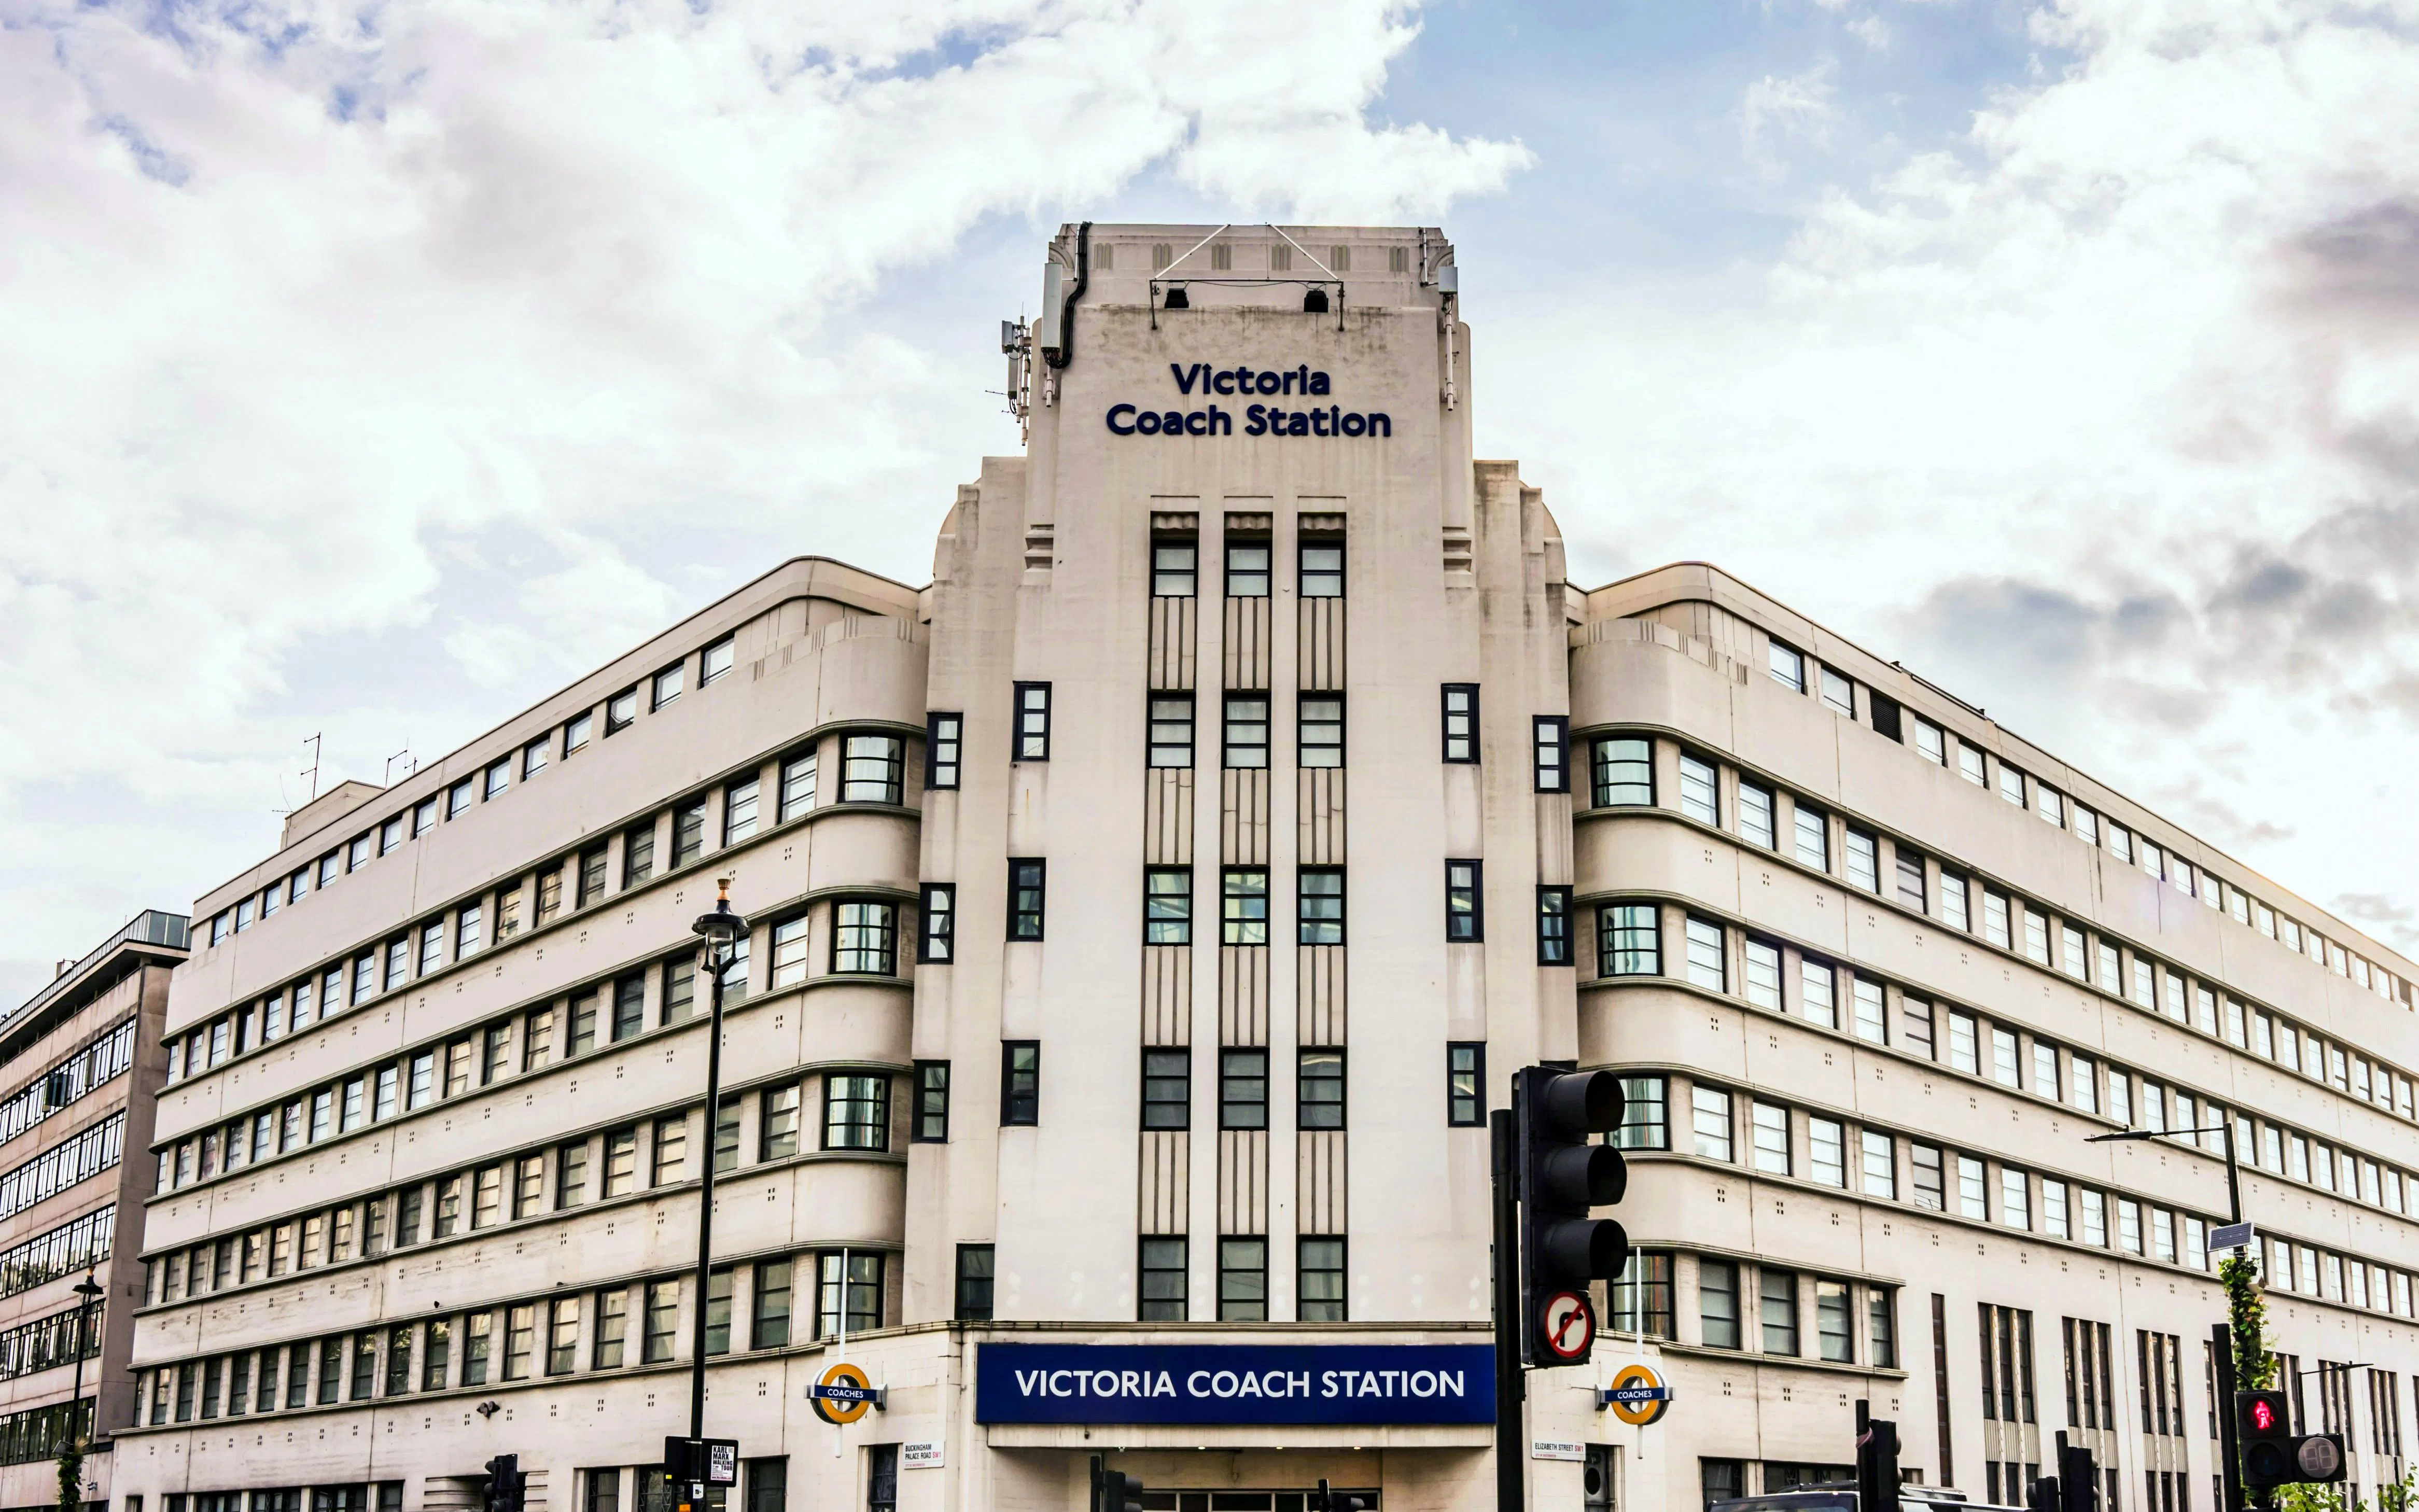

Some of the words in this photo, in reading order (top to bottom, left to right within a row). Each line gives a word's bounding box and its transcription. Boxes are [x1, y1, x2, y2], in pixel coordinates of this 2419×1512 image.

[1170, 363, 1330, 396] Victoria
[1106, 403, 1232, 436] Coach
[1245, 404, 1391, 438] Station
[827, 1389, 864, 1398] COACHES
[1015, 1370, 1177, 1397] VICTORIA
[1187, 1370, 1309, 1397] COACH
[1321, 1370, 1464, 1397] STATION
[1617, 1390, 1653, 1399] COACHES
